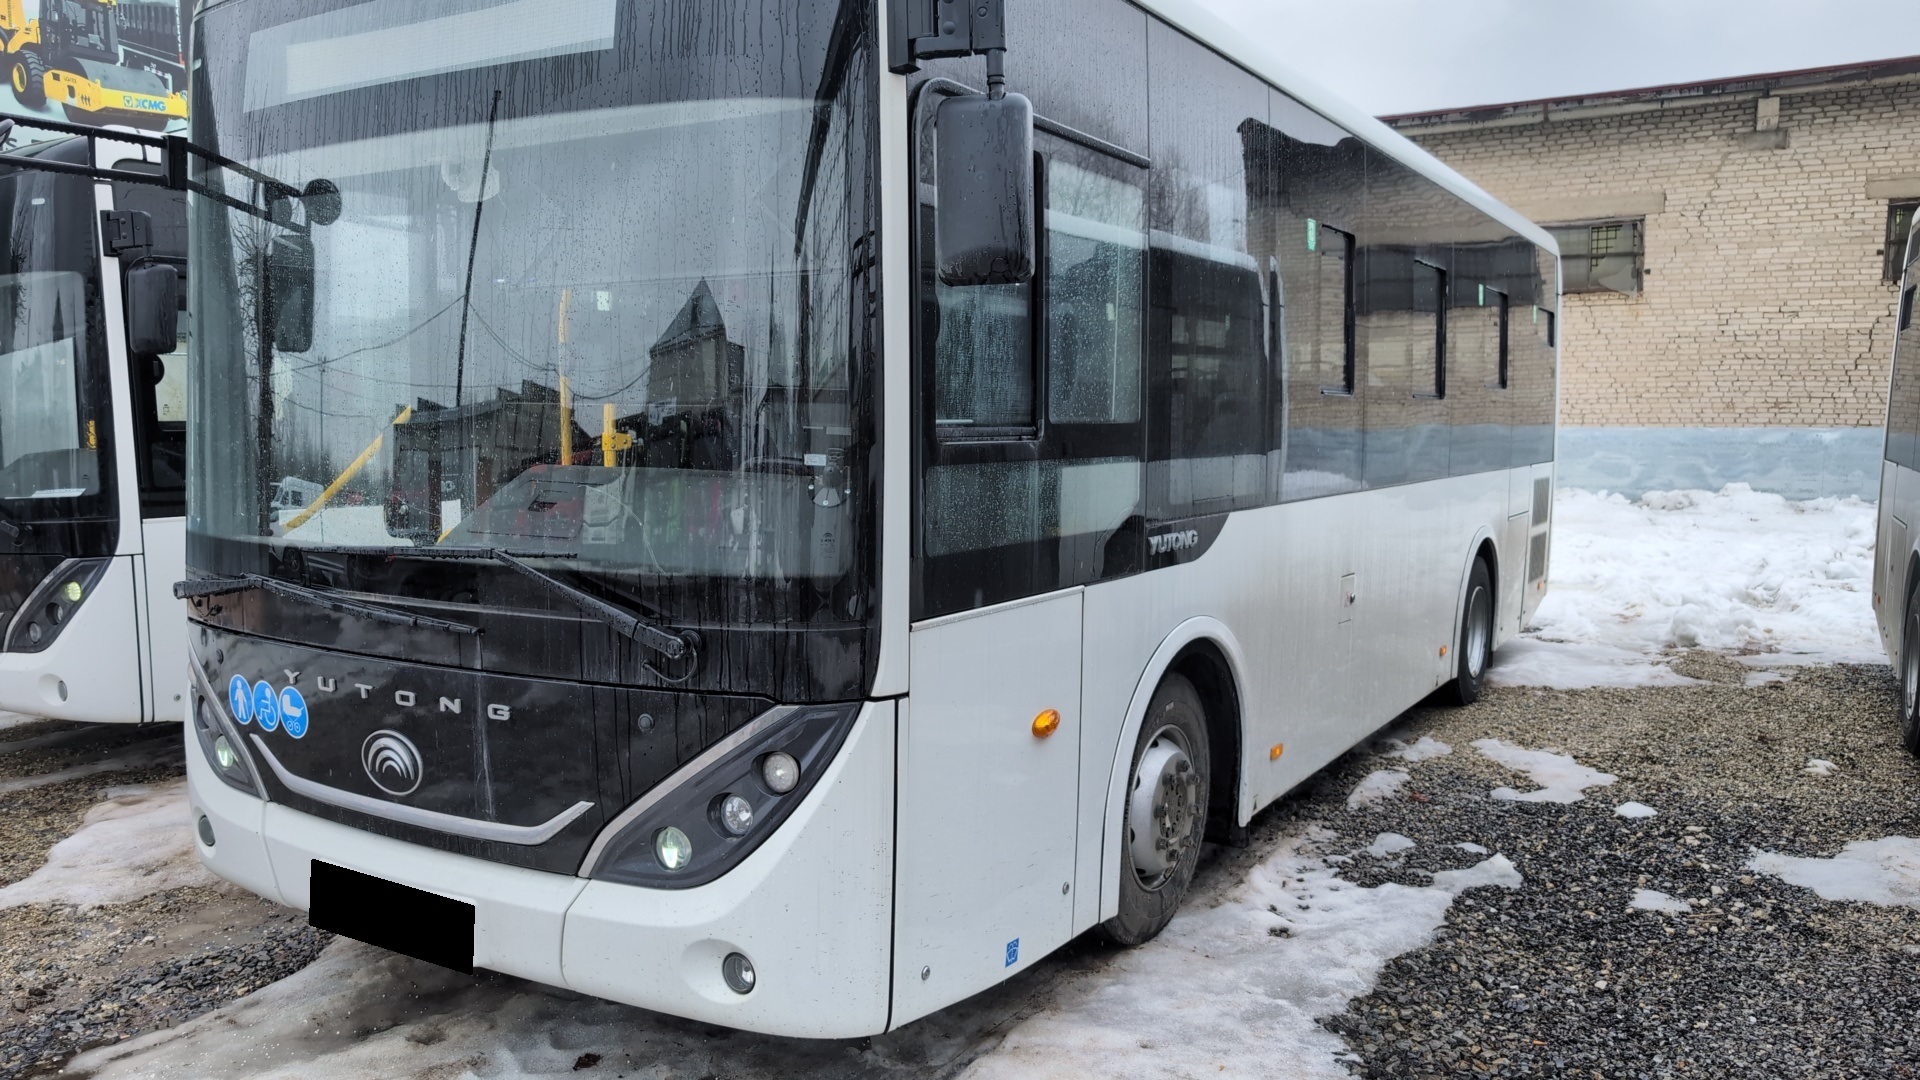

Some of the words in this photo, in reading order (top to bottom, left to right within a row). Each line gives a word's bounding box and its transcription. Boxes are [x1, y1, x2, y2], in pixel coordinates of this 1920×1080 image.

[135, 98, 166, 111] XCMG
[1147, 529, 1199, 555] YUTONG
[283, 668, 511, 721] YUTONG
